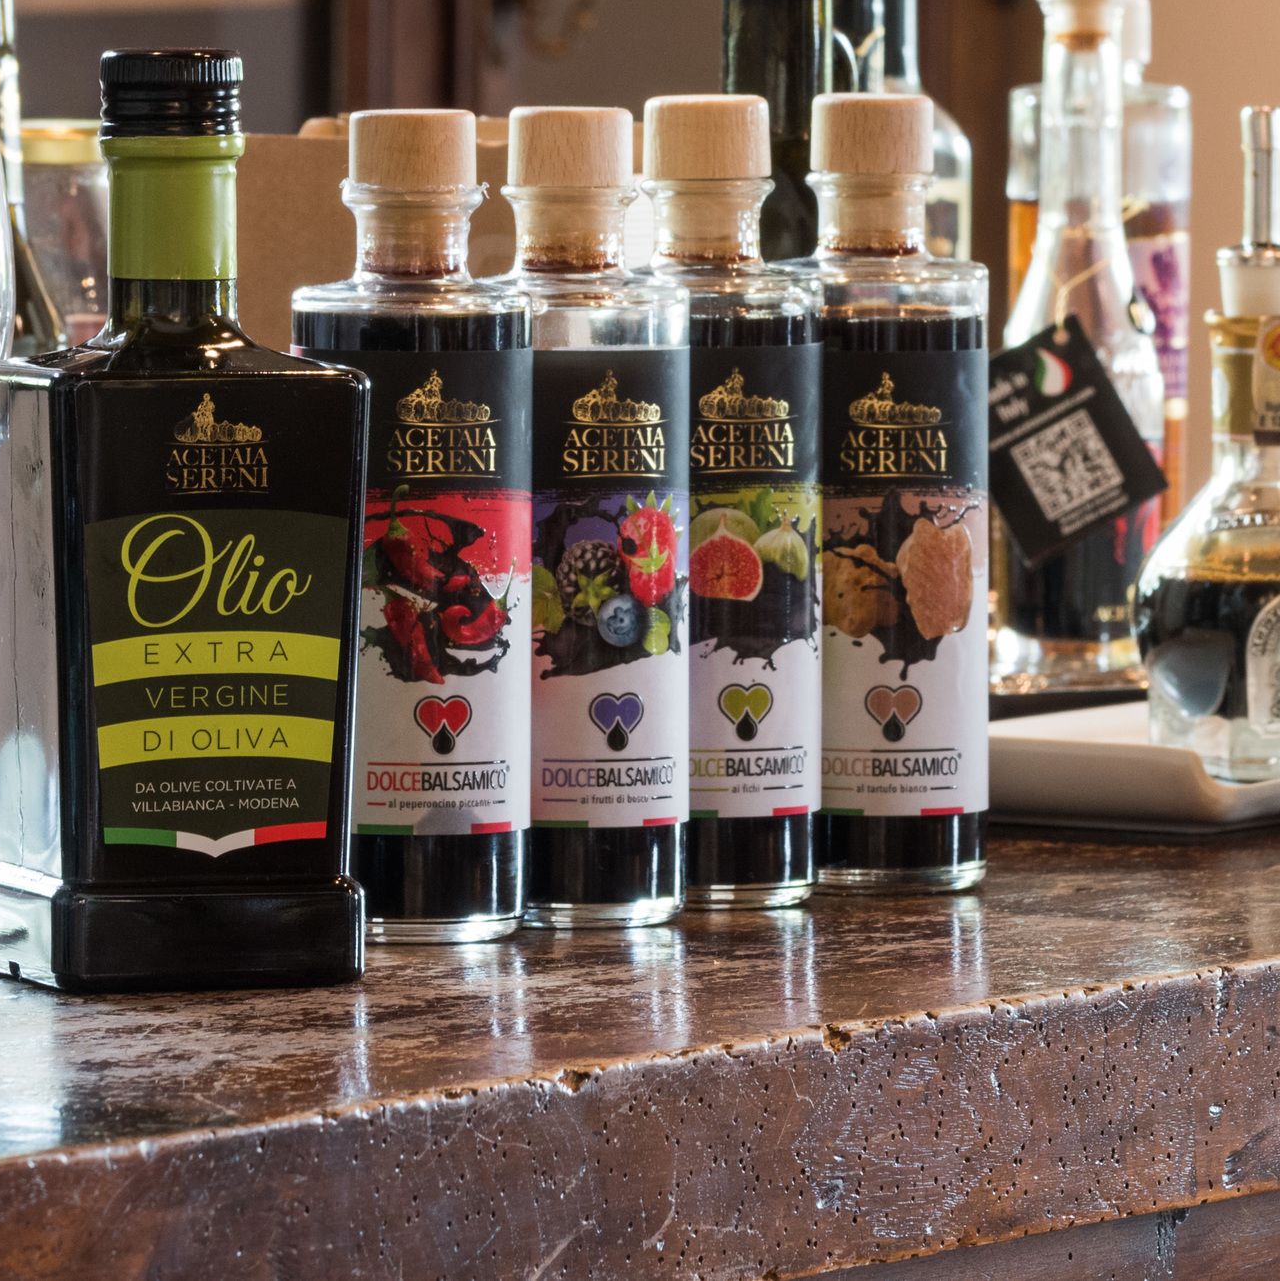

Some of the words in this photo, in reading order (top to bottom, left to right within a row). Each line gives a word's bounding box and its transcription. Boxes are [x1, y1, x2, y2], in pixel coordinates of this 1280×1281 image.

[388, 427, 496, 449] ACETAIA
[564, 427, 665, 449] ACETAIA
[691, 422, 794, 444] ACETAIA
[841, 429, 948, 449] ACETAIA
[166, 447, 268, 466] ACETAIA
[386, 448, 496, 472] SERENI
[562, 447, 665, 472] SERENI
[690, 443, 794, 468] SERENI
[840, 448, 948, 473] SERENI
[166, 466, 268, 489] SERENI
[120, 514, 312, 628] Olio
[144, 639, 289, 666] EXTRA
[145, 683, 289, 709] VERGINE
[142, 730, 174, 753] DI
[191, 726, 289, 751] OLIVA
[690, 755, 804, 778] OLCEBALSAMICO
[135, 782, 155, 794] DA
[159, 781, 201, 793] OLIVE
[205, 779, 282, 792] COLTIVATE
[286, 778, 297, 790] A
[742, 784, 760, 793] fichi
[856, 783, 865, 793] al
[867, 783, 898, 793] tartufo
[899, 783, 928, 793] bianco
[132, 799, 225, 813] VILLABIANCA
[238, 797, 299, 810] MODENA
[388, 800, 397, 809] al
[399, 799, 457, 811] peperoncino
[580, 796, 590, 805] ai
[592, 795, 614, 804] frutti
[616, 794, 624, 804] di
[627, 794, 648, 803] bosco
